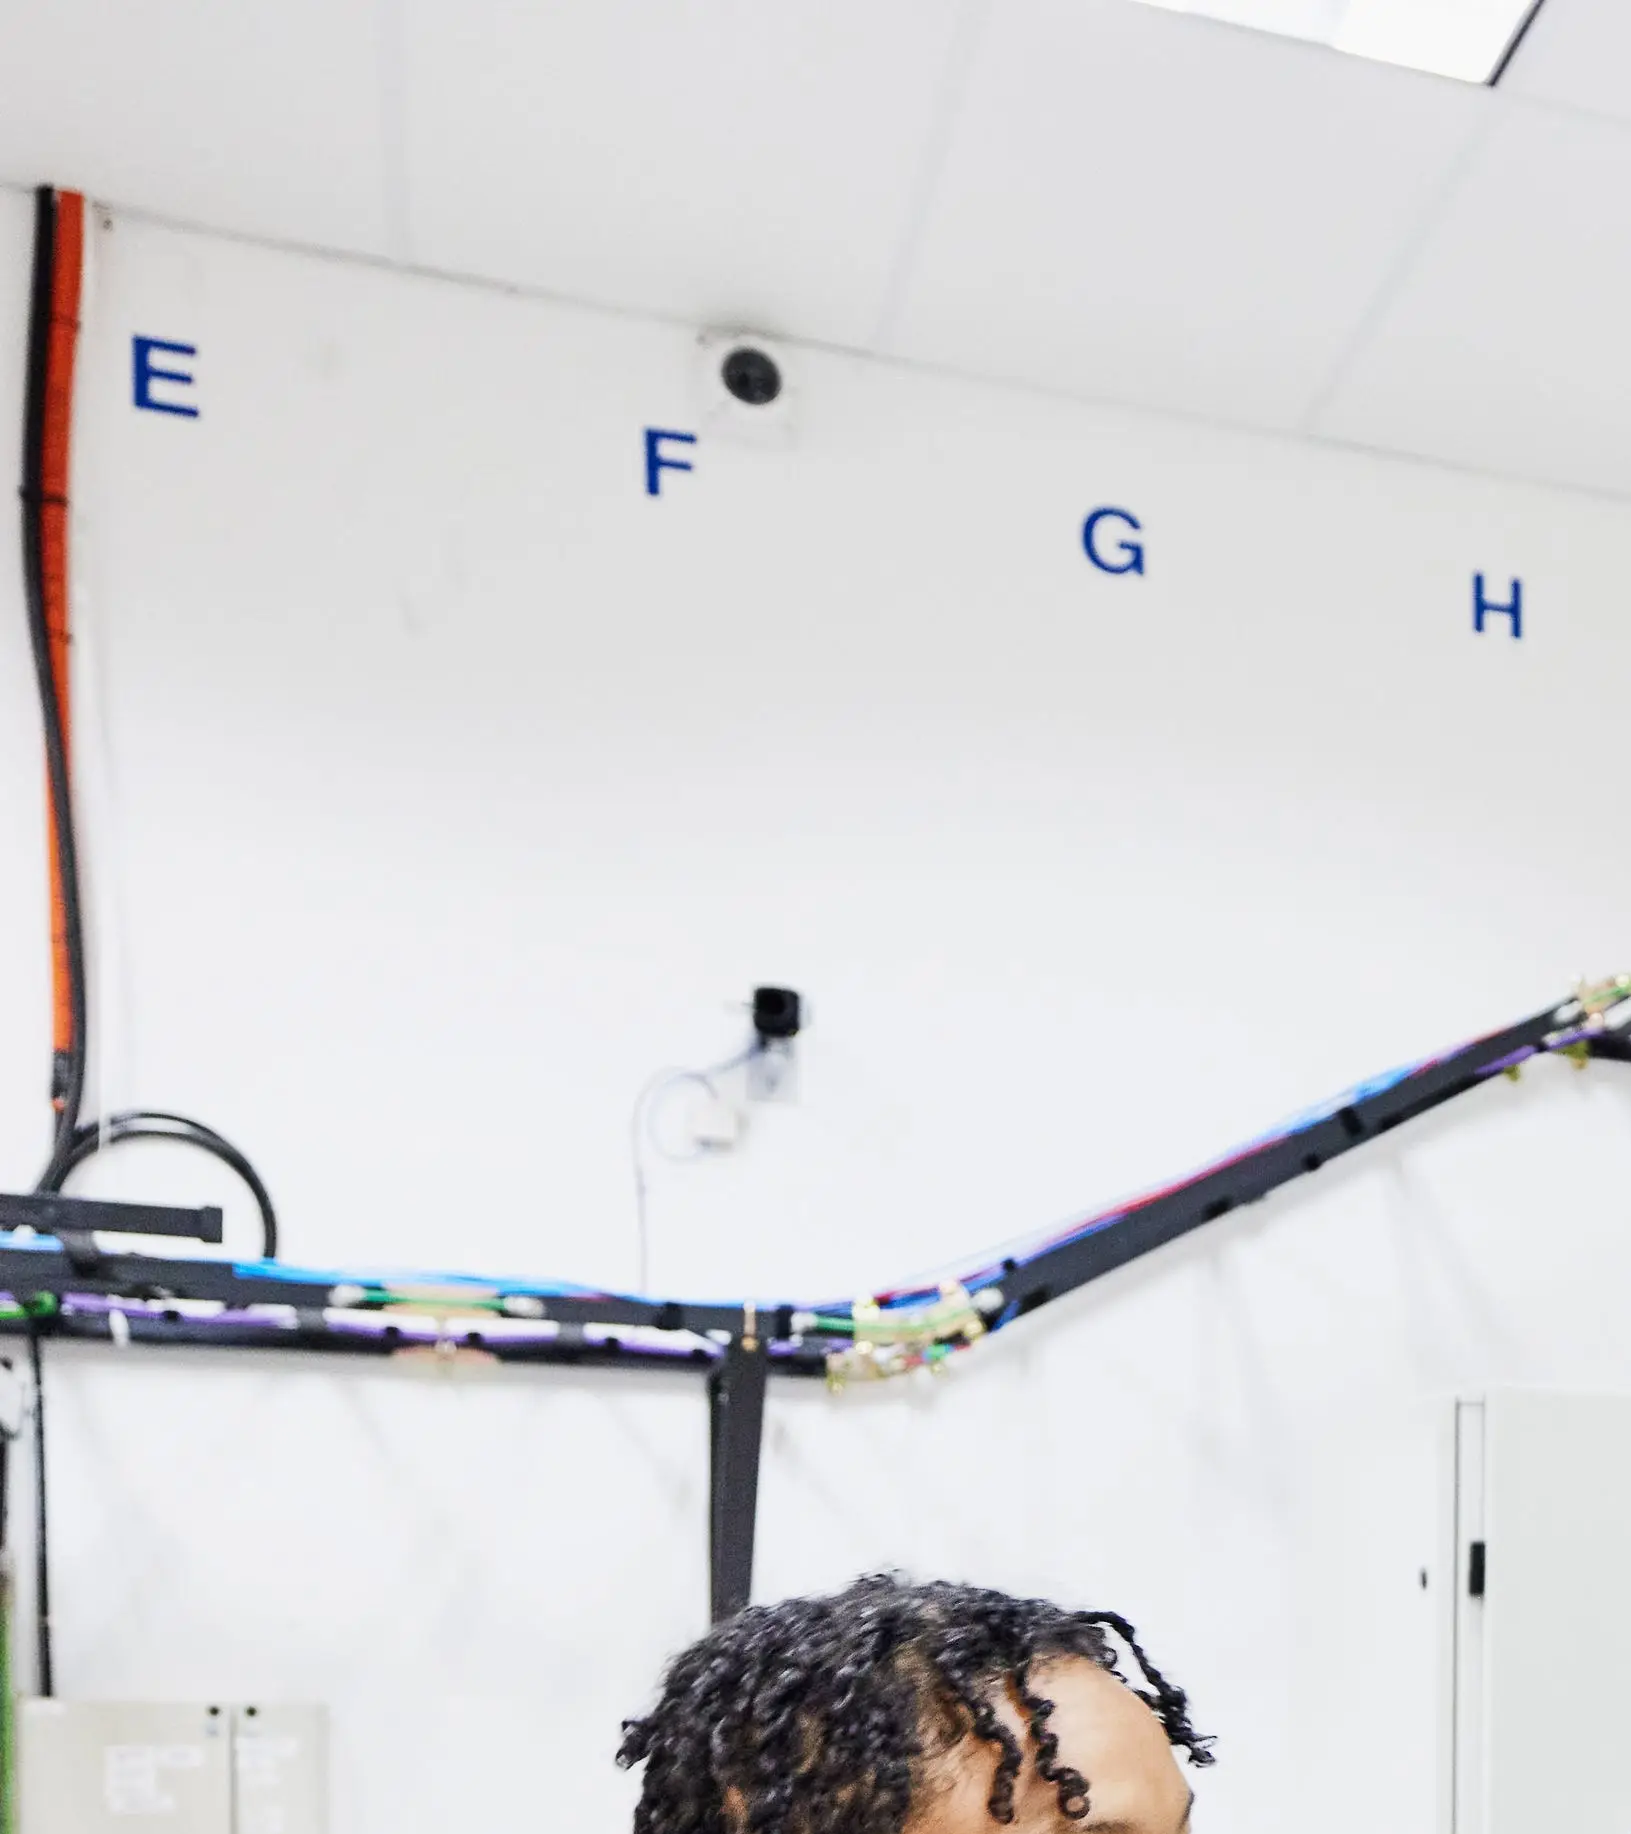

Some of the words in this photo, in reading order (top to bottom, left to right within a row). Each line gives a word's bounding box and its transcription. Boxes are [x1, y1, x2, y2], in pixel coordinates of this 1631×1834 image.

[131, 335, 200, 418] E
[643, 428, 697, 497] F
[1081, 506, 1146, 576] G
[1472, 573, 1524, 640] H
